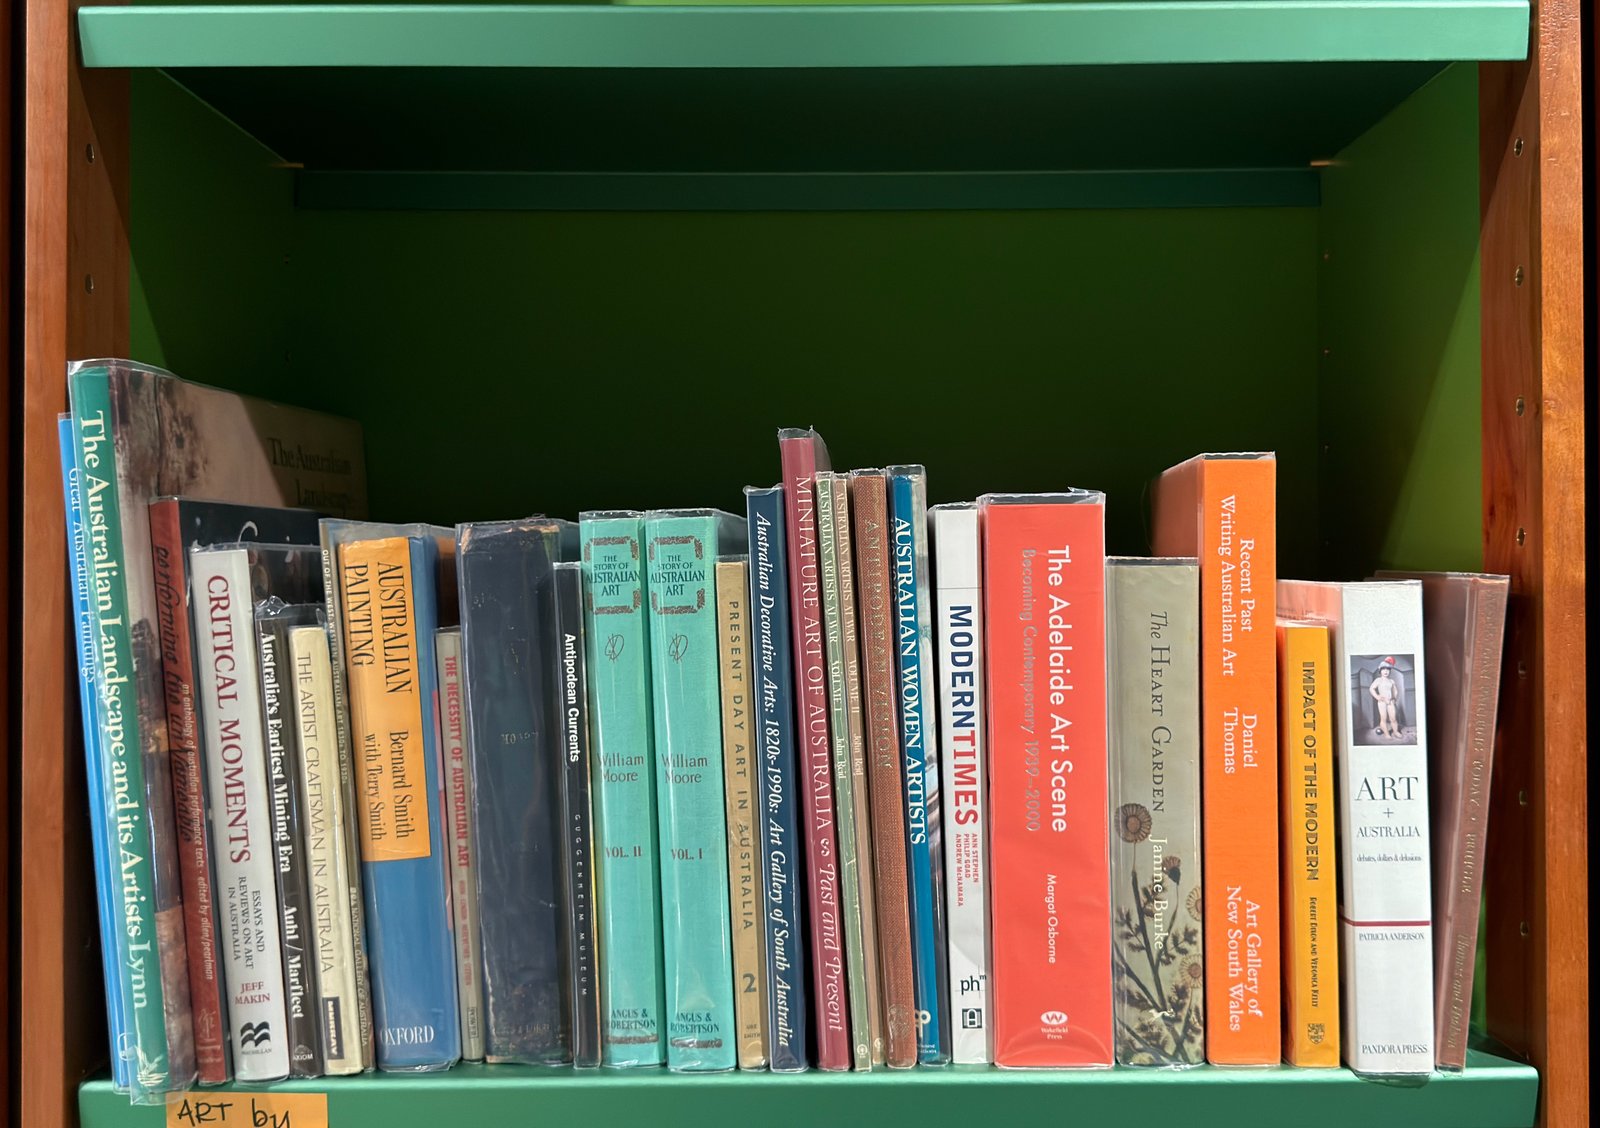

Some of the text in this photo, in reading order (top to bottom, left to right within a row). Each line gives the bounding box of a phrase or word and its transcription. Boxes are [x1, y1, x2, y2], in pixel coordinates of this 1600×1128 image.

[819, 489, 835, 554] AUSTRALIAN
[836, 490, 849, 554] AUSTRALIAN
[585, 570, 641, 583] AUSTRALIAN
[593, 562, 630, 571] STORY OF
[603, 554, 618, 563] THE
[650, 570, 706, 583] AUSTRALIAN
[667, 554, 682, 563] THE
[824, 559, 836, 601] ARTISTS
[841, 560, 853, 602] ARTISTS
[1019, 549, 1037, 621] Becoming
[1217, 494, 1238, 676] Writing Australian Art
[1239, 538, 1256, 632] Recent Past
[345, 562, 376, 667] PAINTING
[601, 584, 621, 597] ART
[665, 584, 686, 597] ART
[377, 562, 413, 694] AUSTRALIAN
[828, 619, 839, 643] WAR
[844, 619, 855, 643] WAR
[865, 518, 893, 769] ANTIPODEAN VISION
[444, 656, 458, 677] THE
[831, 660, 842, 705] VOLUME
[848, 658, 859, 704] VOLUME
[894, 517, 926, 845] AUSTRALIAN WOMEN ARTISTS
[1020, 625, 1038, 735] Contemporary
[1047, 544, 1074, 833] The Adelaide Art Scene
[80, 410, 151, 1010] The Australian Landscape and its Artists Lynn
[207, 575, 251, 864] CRITICAL MOMENTS
[447, 682, 463, 740] NECESSITY
[564, 633, 580, 763] Antipodean Currents
[1150, 611, 1172, 813] The HEART GARDEN
[260, 632, 293, 873] Australia's Earliest Mining Era
[451, 747, 464, 762] OF
[661, 752, 708, 768] William
[729, 601, 754, 930] PRESENT DAY ART IN AUSTRALIA
[795, 476, 843, 1032] MINIATURE ART OF AUSTRALIA Past and Present
[836, 735, 846, 758] John
[853, 734, 862, 757] John
[853, 758, 864, 777] Reid
[1223, 706, 1239, 774] Thomas
[1242, 713, 1259, 769] Daniel
[364, 733, 388, 841] with Terry Smith
[389, 730, 416, 839] Bernard Smith
[664, 770, 702, 784] Moore
[756, 511, 794, 1047] Australian Decorative Arts: 1820s-1990s: Art Gallery of South Australia
[837, 759, 847, 779] Reid
[1302, 661, 1319, 881] IMPACT OF THE MODERN
[1354, 776, 1419, 801] ART
[297, 652, 334, 973] THE ARTIST CRAFTSMAN IN AUSTRALIA
[452, 767, 469, 840] AUSTRALIAN
[1356, 826, 1421, 838] AUSTRALIA
[1382, 807, 1394, 819] +
[457, 844, 470, 868] ART
[671, 848, 703, 861] VOL. I
[955, 833, 965, 907] ANDREW McNAMARA
[963, 833, 972, 879] PHILIP GOAD
[972, 849, 980, 883] STEPHEN
[574, 814, 588, 996] GUGGENHEIM MUSEUM
[1044, 874, 1060, 964] Margot Osborne
[1148, 834, 1170, 950] Janine Burke
[228, 886, 243, 961] IN AUSTRALIA
[238, 876, 255, 969] REVIEWS ON ART
[252, 890, 266, 953] ESSAYS AND
[283, 905, 299, 940] Auhl
[1358, 931, 1425, 941] PATRICIA ANDERSON
[287, 955, 305, 1019] Marfleet
[742, 973, 757, 993] 2
[1226, 885, 1245, 1032] New South Wales
[1244, 899, 1264, 1018] Art Gallery of
[234, 981, 271, 1005] JEFF MAKIN
[379, 1024, 435, 1046] OXFORD
[1361, 1044, 1428, 1054] PANDORA PRESS
[177, 1098, 290, 1128] ART by
